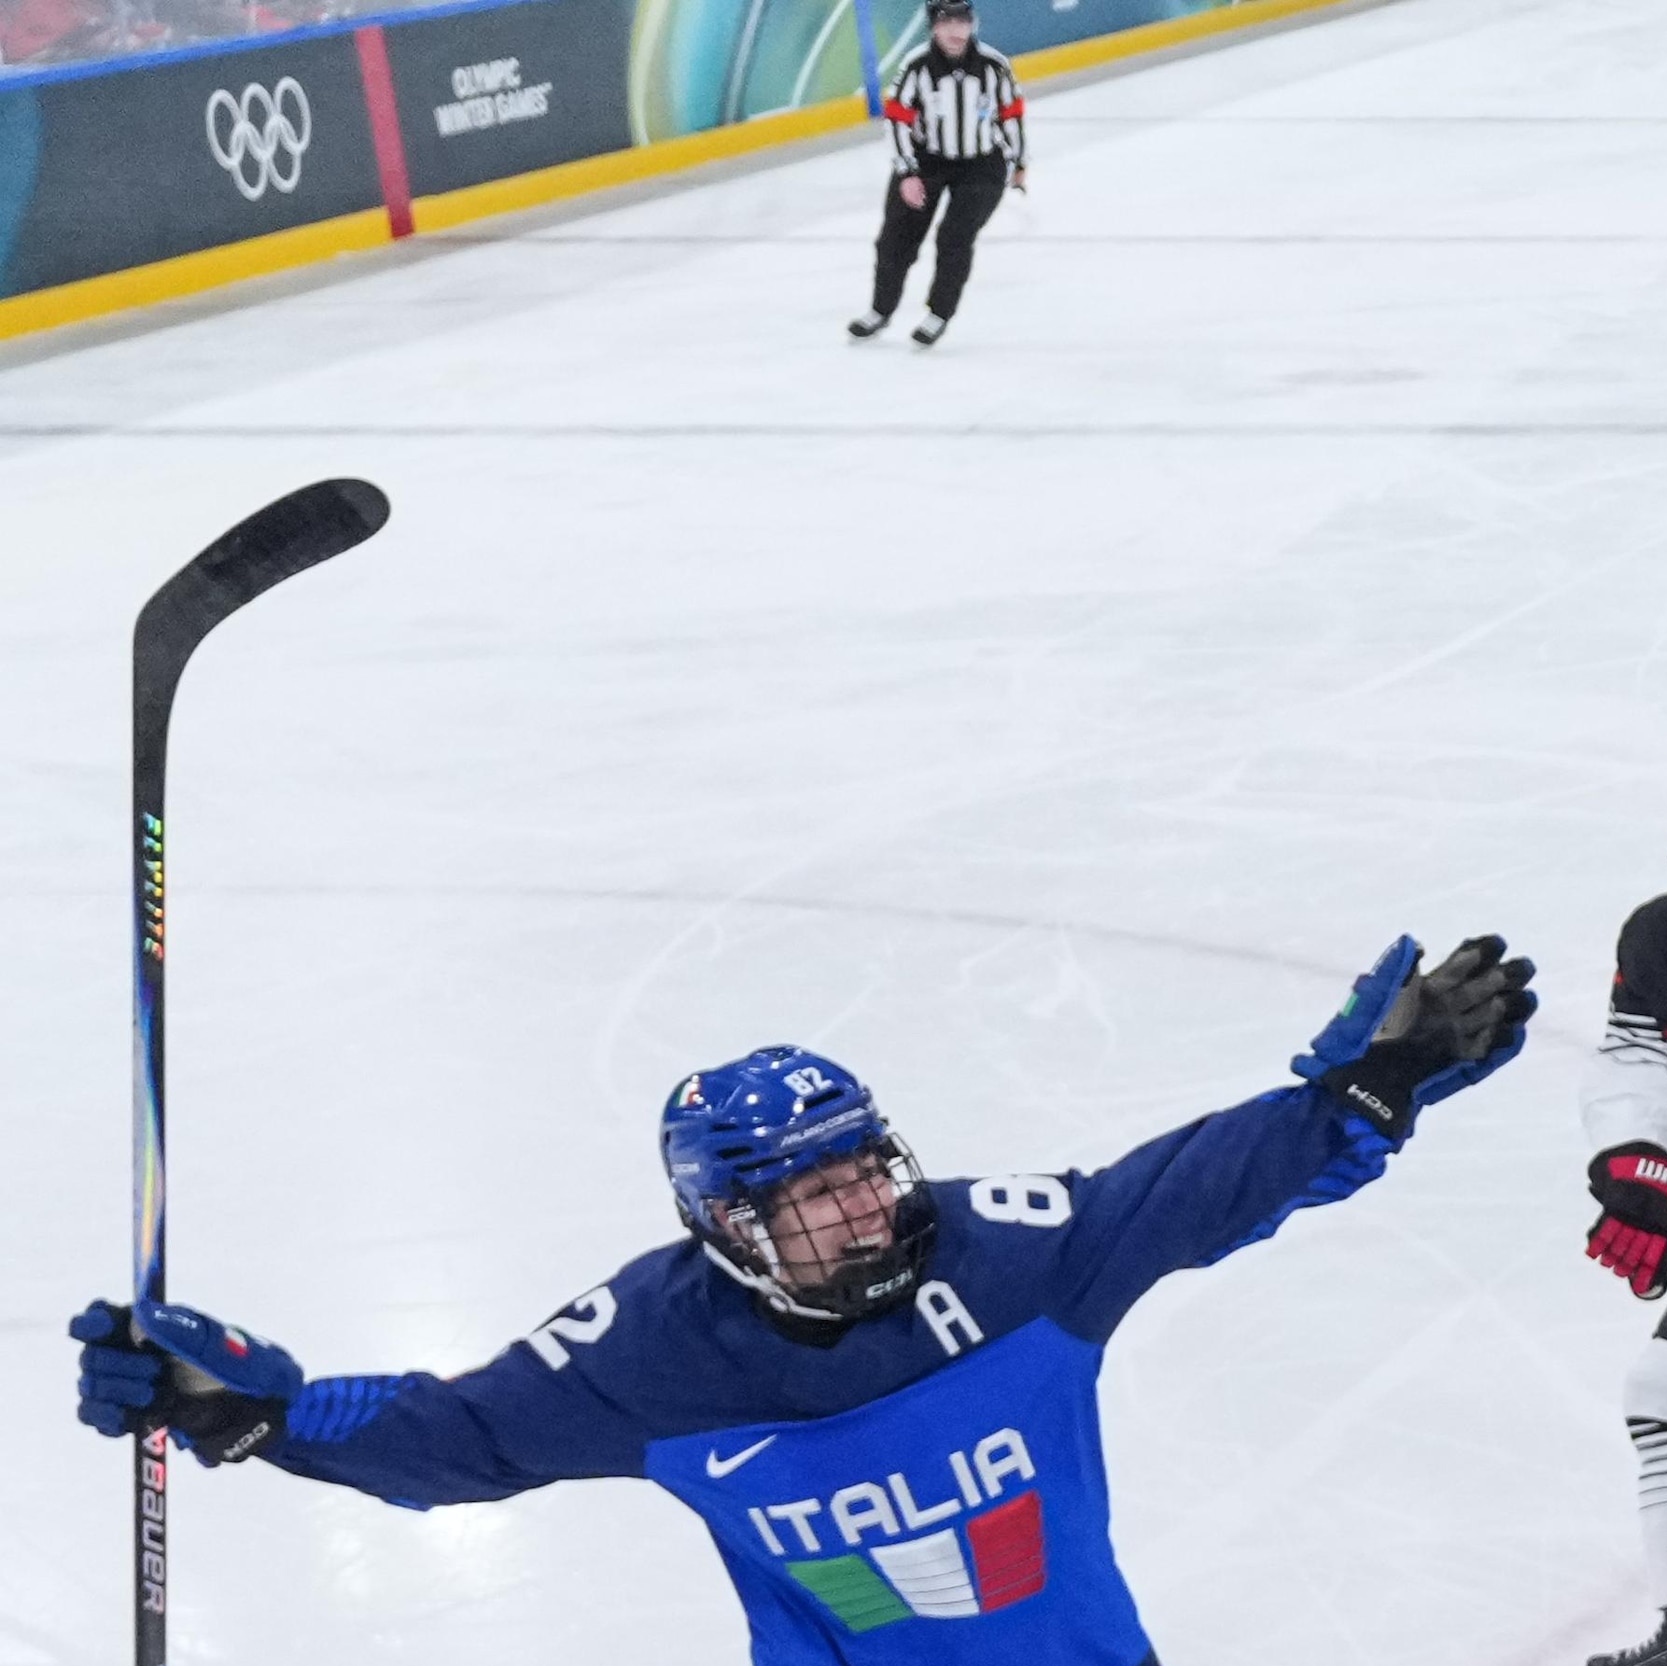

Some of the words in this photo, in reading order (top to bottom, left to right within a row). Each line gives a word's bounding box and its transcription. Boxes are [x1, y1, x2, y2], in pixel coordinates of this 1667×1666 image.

[433, 96, 495, 137] WINTER
[783, 1066, 834, 1098] 82
[1346, 1083, 1394, 1120] CCM
[915, 1280, 984, 1354] A
[747, 1428, 1035, 1556] ITALIA
